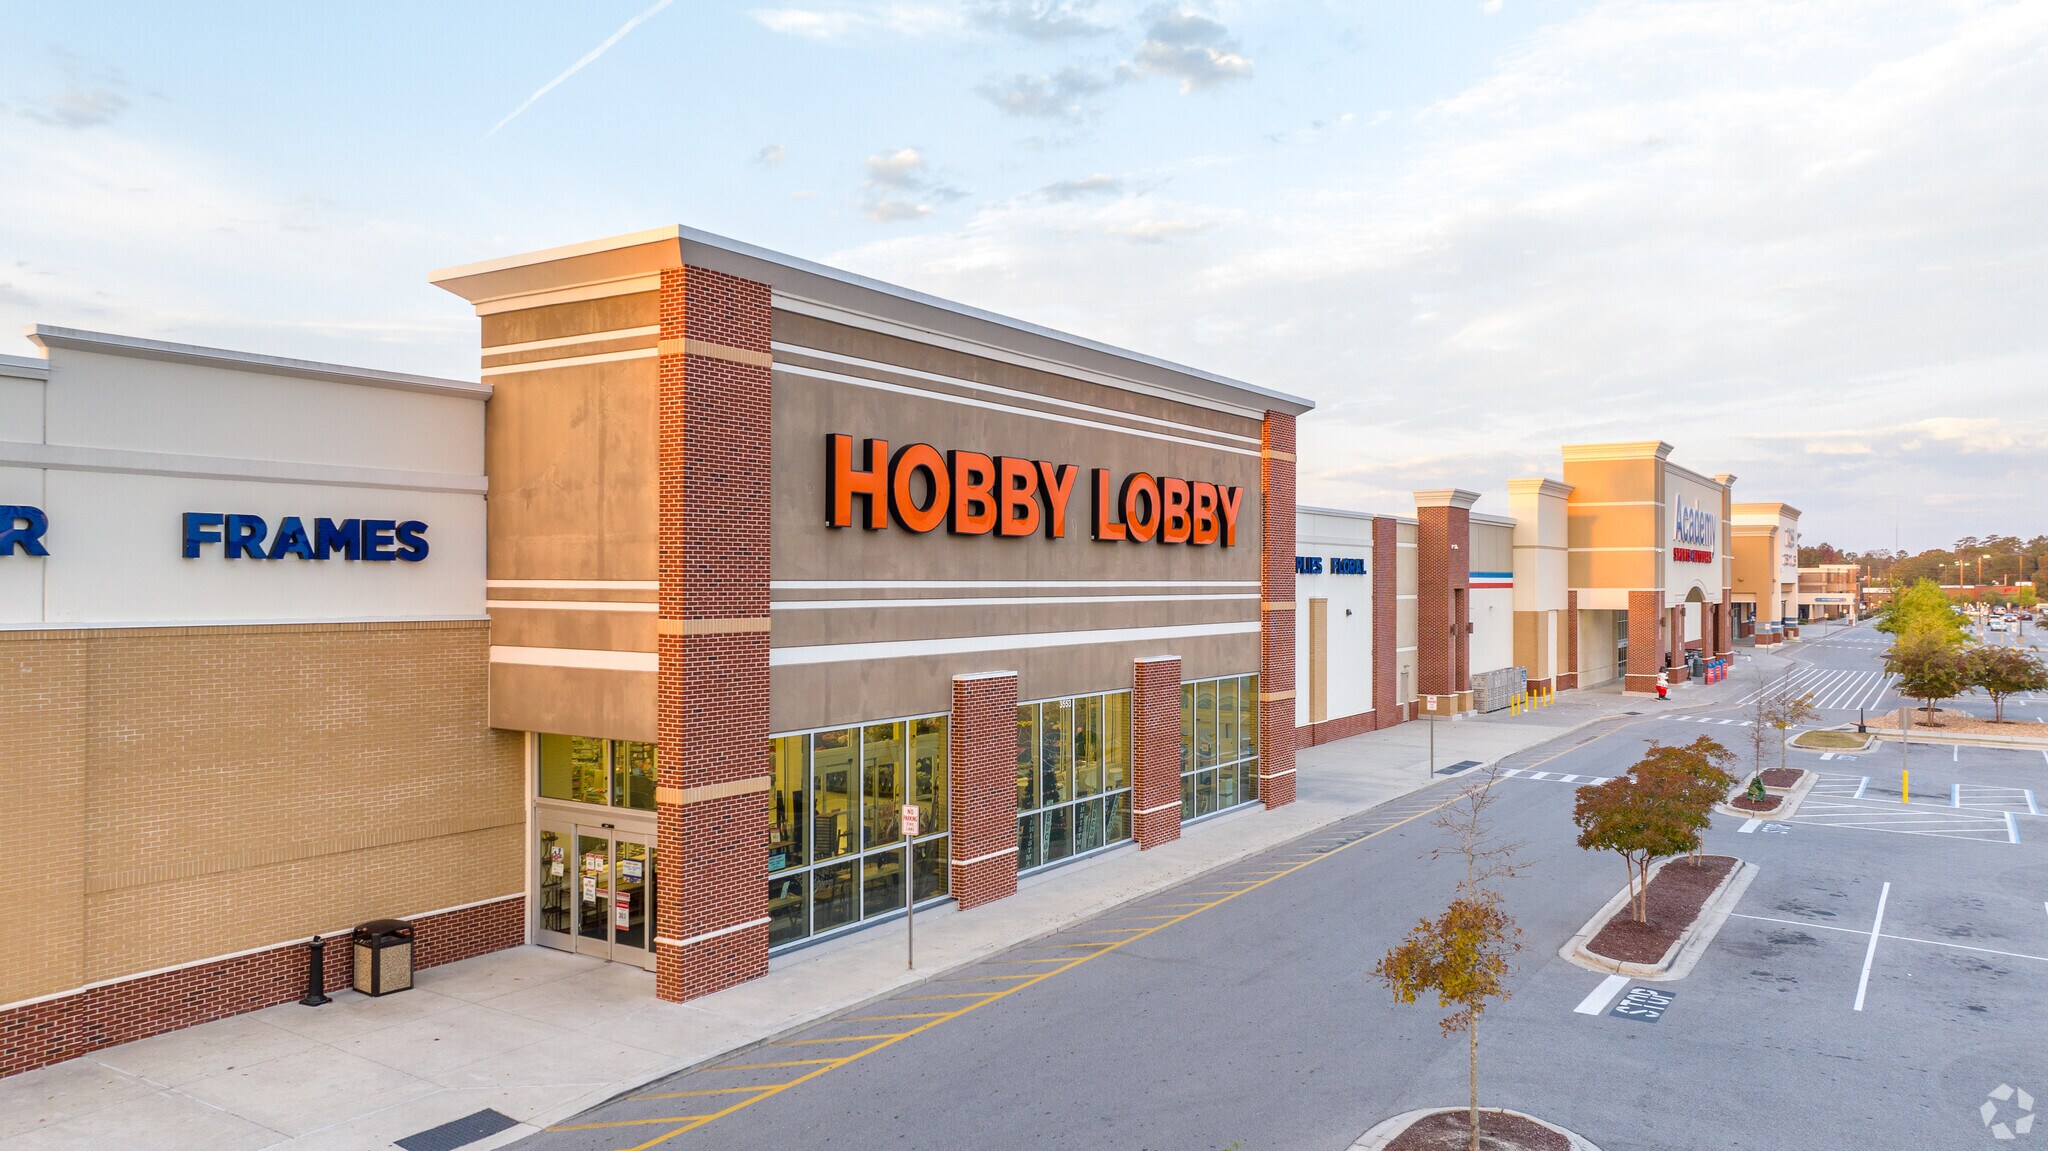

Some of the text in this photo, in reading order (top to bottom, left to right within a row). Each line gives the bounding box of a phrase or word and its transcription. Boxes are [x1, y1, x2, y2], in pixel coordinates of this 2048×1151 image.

[826, 433, 1244, 548] HOBBY LOBBY
[0, 505, 429, 562] R FRAMES
[1674, 494, 1717, 558] Academy
[1330, 558, 1367, 574] FLORAL
[1615, 988, 1673, 1018] STOP
